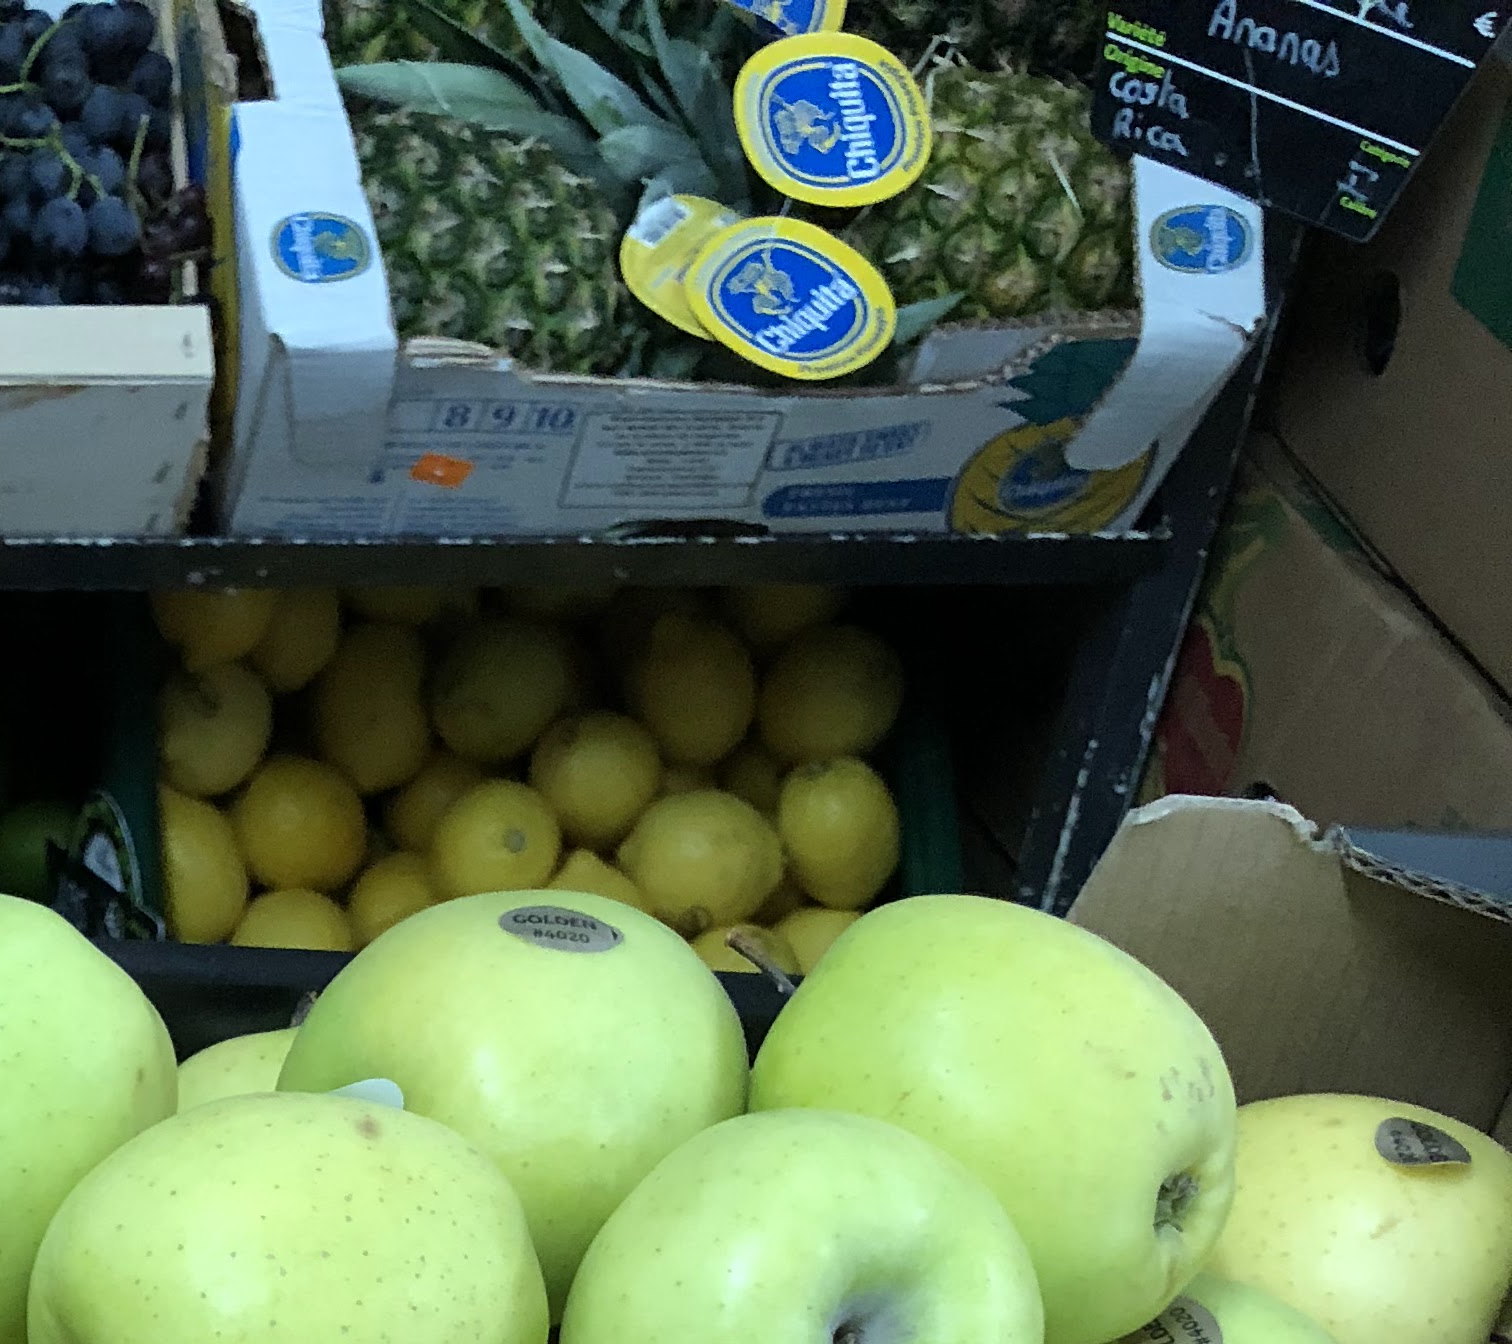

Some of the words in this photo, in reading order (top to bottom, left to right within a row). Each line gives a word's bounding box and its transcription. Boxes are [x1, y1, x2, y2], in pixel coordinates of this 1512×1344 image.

[1207, 0, 1341, 78] Ananas
[828, 61, 880, 181] Chiquita
[757, 272, 859, 356] Chiquita
[444, 404, 472, 428] 8
[536, 405, 575, 429] 10
[512, 913, 598, 931] GOLDEN
[533, 928, 591, 944] #4020
